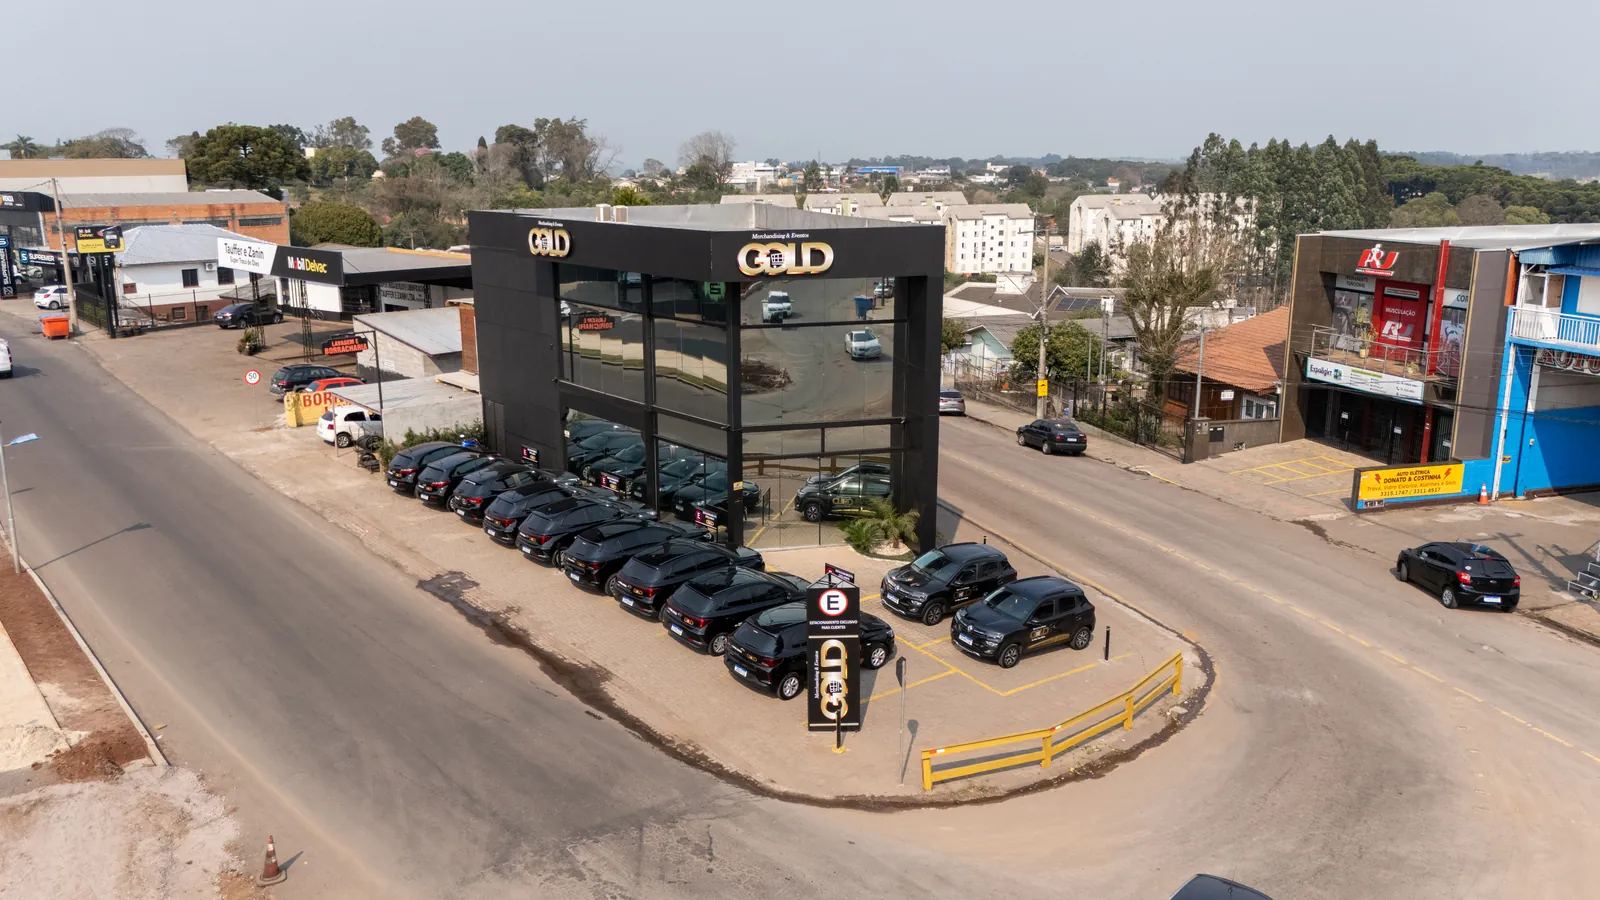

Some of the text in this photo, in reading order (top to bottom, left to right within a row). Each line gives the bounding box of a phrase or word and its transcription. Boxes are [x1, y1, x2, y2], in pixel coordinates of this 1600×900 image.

[528, 227, 570, 257] GOLD
[224, 242, 265, 260] Tauffer e Zanin
[287, 256, 327, 274] Mobil Delvac
[737, 242, 834, 276] GOLD
[1385, 307, 1416, 316] MUSCULAÇÃO
[324, 343, 368, 356] BORRACHARIA
[331, 338, 355, 347] LAVAGEM
[248, 372, 257, 380] 50
[1413, 474, 1441, 482] COSTINHA
[827, 595, 839, 610] E
[820, 639, 848, 720] GOLD
